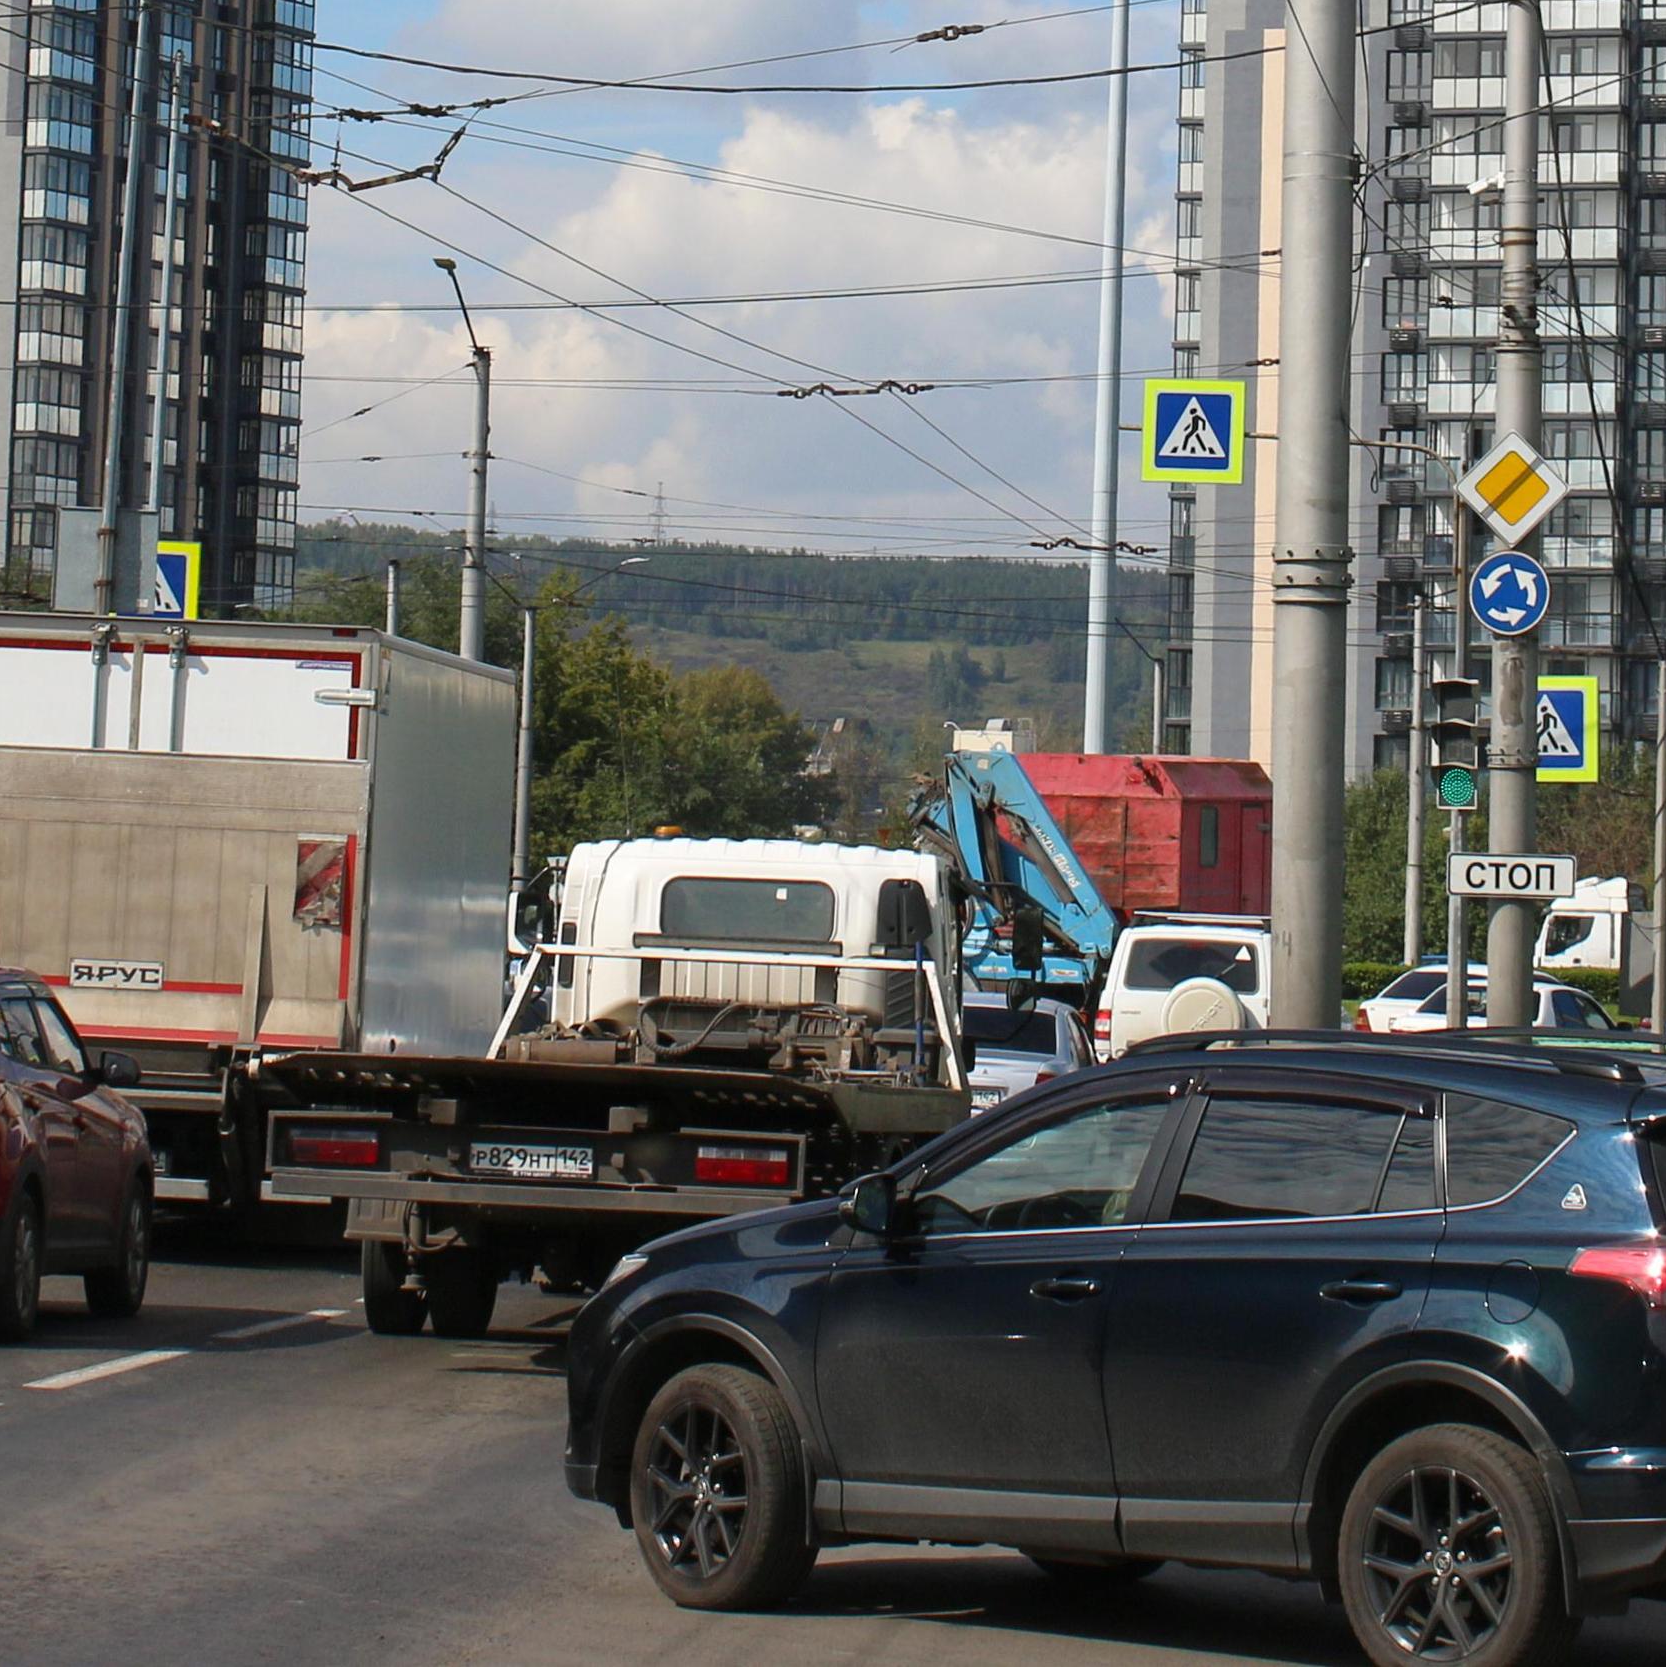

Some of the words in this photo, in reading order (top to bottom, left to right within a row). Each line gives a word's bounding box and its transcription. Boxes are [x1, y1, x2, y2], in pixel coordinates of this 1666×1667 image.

[1465, 861, 1556, 891] СТОП
[74, 965, 160, 984] ЯРУС
[475, 1146, 554, 1170] Р829НТ
[558, 1149, 589, 1166] 142
